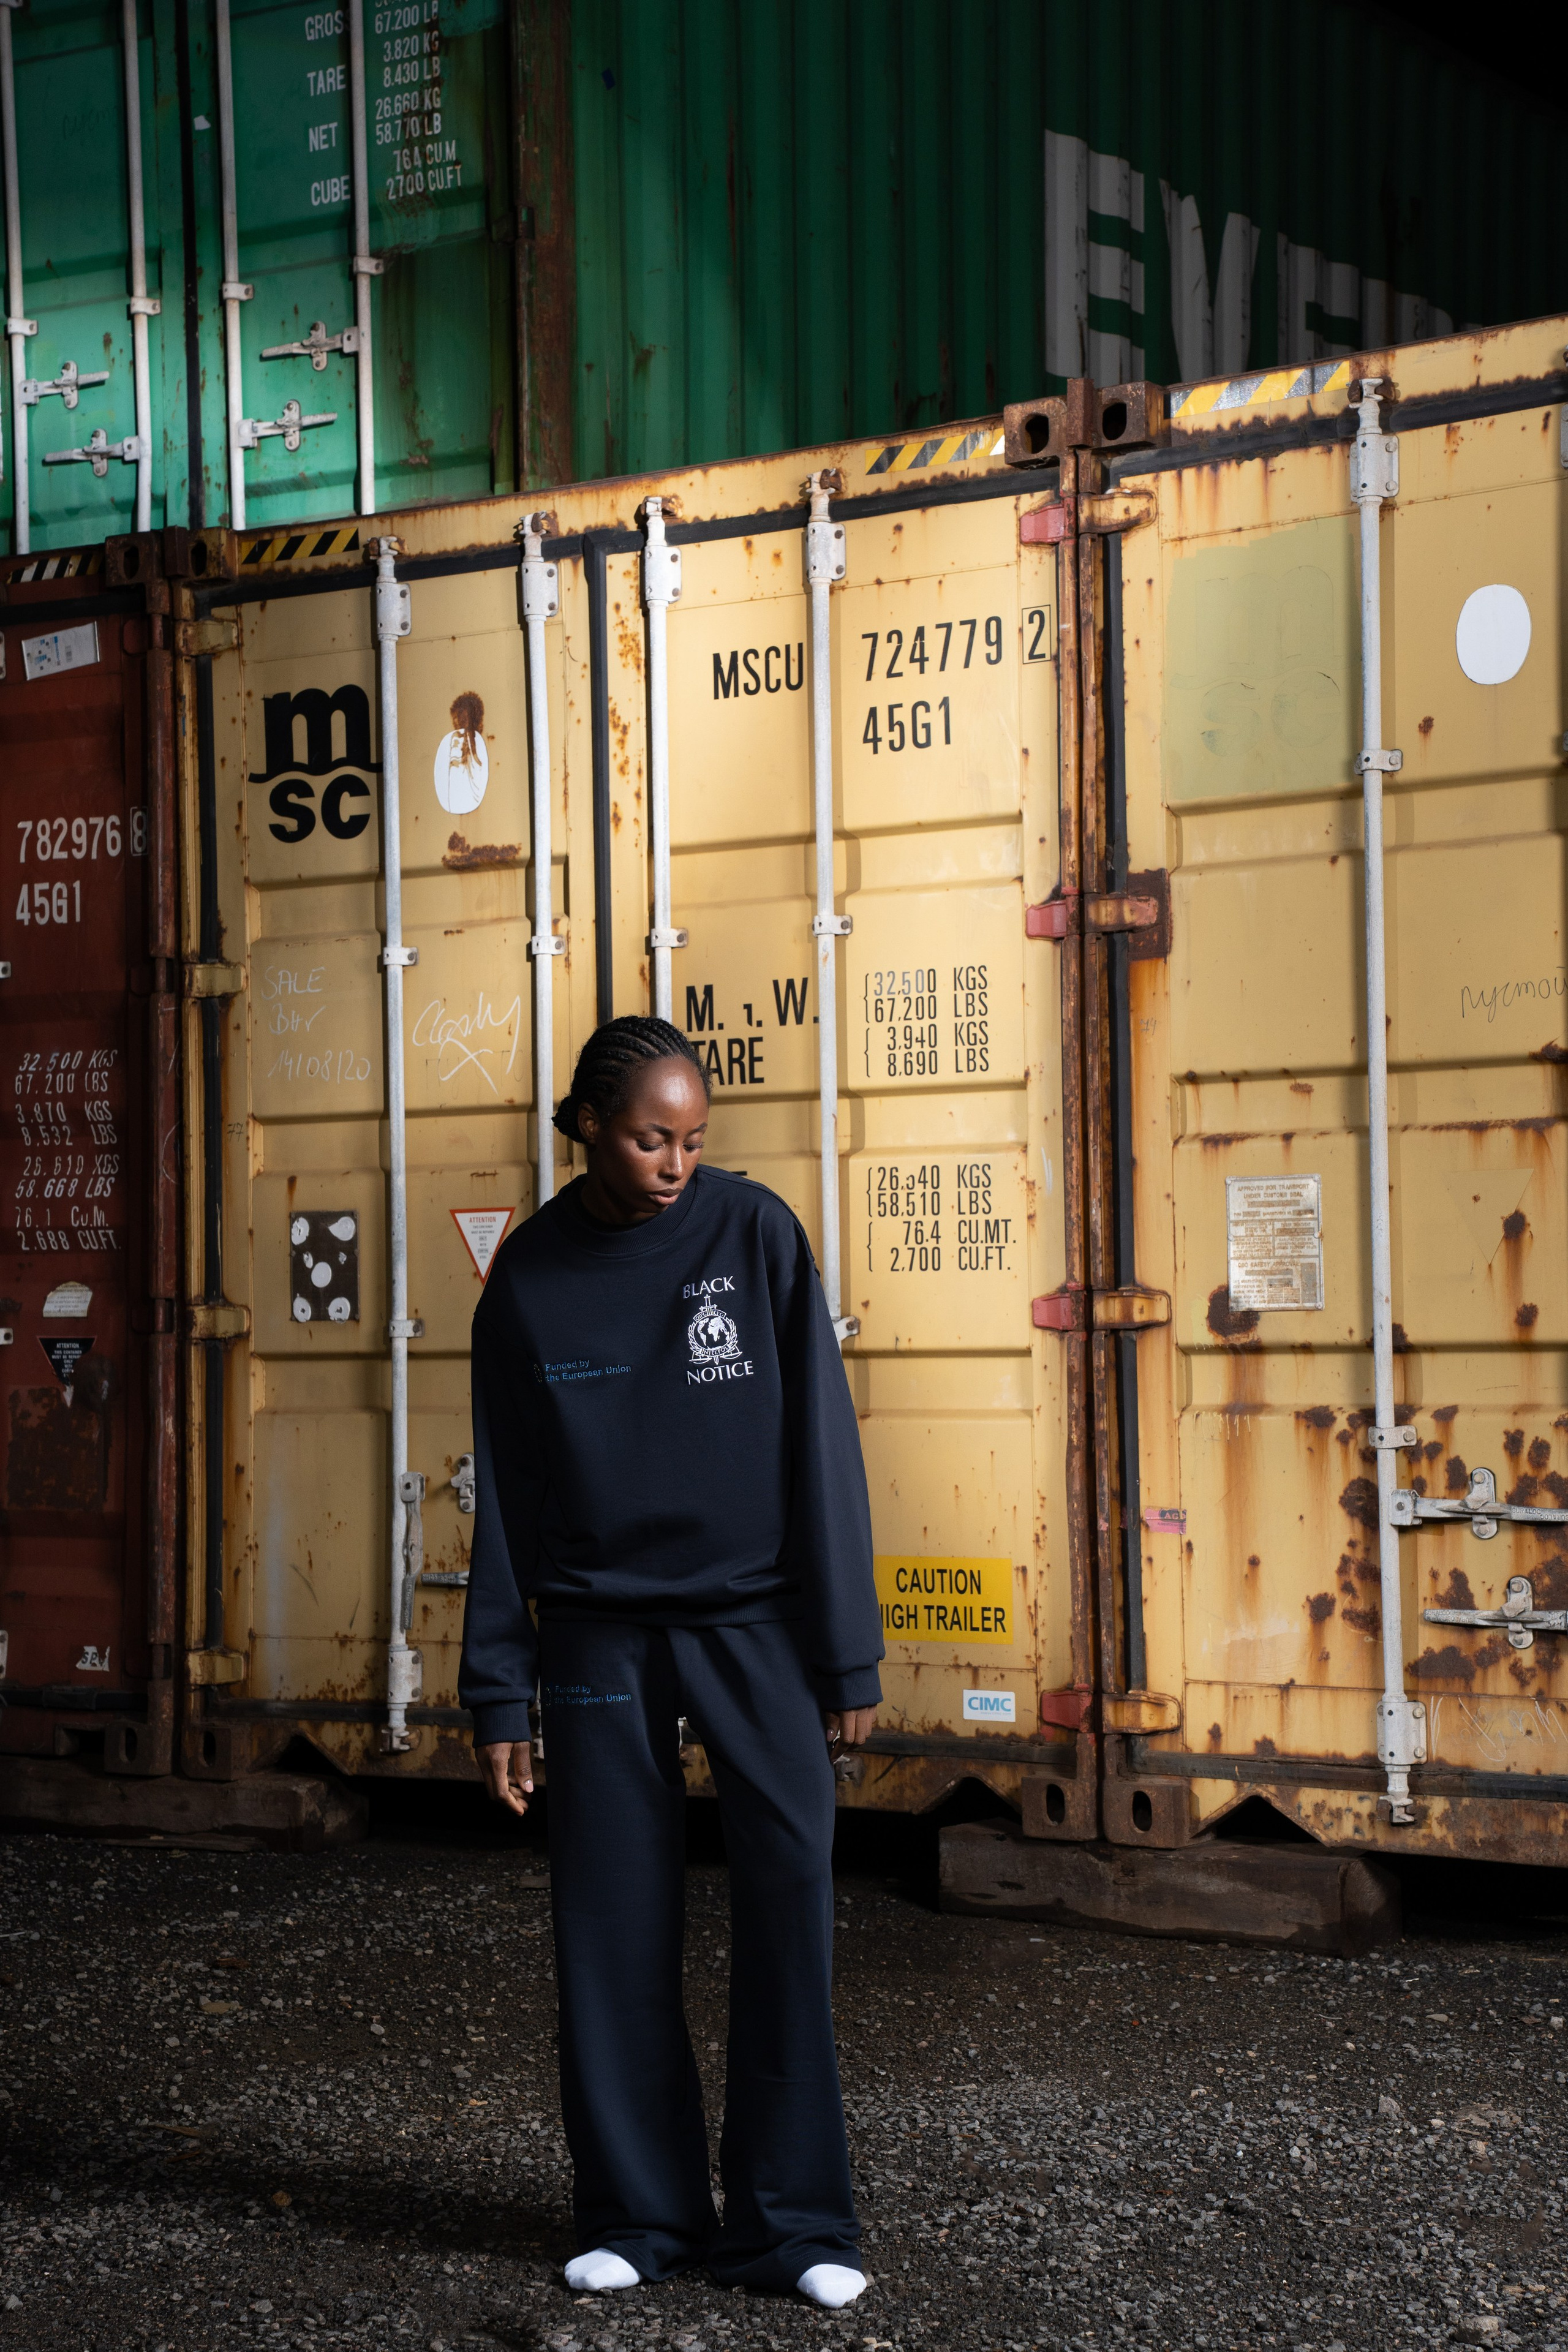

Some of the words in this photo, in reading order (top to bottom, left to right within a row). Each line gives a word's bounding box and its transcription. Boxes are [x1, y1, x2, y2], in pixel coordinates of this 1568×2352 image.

[305, 10, 350, 41] GROS
[375, 5, 419, 34] 67.200
[424, 0, 439, 23] LB
[383, 35, 419, 62] 3.820
[423, 31, 439, 53] KG
[307, 64, 346, 96] TARE
[383, 61, 419, 88] 8.430
[423, 56, 440, 80] LB
[375, 91, 420, 120] 26.660
[423, 86, 441, 110] KG
[309, 122, 338, 153] NET
[375, 116, 421, 145] 58.770
[424, 113, 442, 135] LB
[311, 175, 351, 206] CUBE
[427, 165, 462, 191] CU.FT
[861, 616, 1003, 682] 724779
[1028, 609, 1046, 660] 2
[712, 642, 804, 699] MSCU
[862, 696, 952, 755] 45G1
[17, 815, 122, 864] 782976
[132, 810, 147, 852] 8
[16, 880, 81, 925] 45G1
[262, 965, 326, 1000] SALE
[873, 968, 937, 997] 32,500
[954, 965, 987, 991] KGS
[686, 984, 724, 1033] M.
[772, 977, 820, 1027] W.
[875, 995, 937, 1023] 67,200
[954, 992, 988, 1018] LBS
[888, 1023, 937, 1051] 3,940
[954, 1020, 989, 1047] KGS
[19, 1050, 83, 1071] 32.500
[88, 1049, 118, 1069] KGS
[888, 1050, 938, 1077] 8,690
[955, 1047, 989, 1073] LBS
[15, 1073, 75, 1095] 67.200
[85, 1072, 108, 1093] LBS
[15, 1102, 67, 1123] 3.870
[85, 1101, 113, 1121] KGS
[21, 1126, 73, 1147] 8.532
[91, 1124, 118, 1145] LBS
[23, 1155, 84, 1176] 26.610
[92, 1154, 119, 1175] KGS
[957, 1164, 992, 1189] KGS
[15, 1178, 78, 1199] 58.668
[85, 1177, 115, 1198] LBS
[15, 1206, 51, 1228] 76.1
[878, 1191, 940, 1217] 58,510
[958, 1190, 992, 1215] LBS
[17, 1231, 70, 1251] 2.688
[903, 1220, 941, 1245] 76.4
[958, 1219, 1016, 1244] CU.MT.
[891, 1246, 941, 1272] 2,700
[959, 1246, 1011, 1271] CU.FT.
[683, 1276, 735, 1298] BLACK
[701, 1345, 729, 1356] INTERPOL
[545, 1360, 578, 1371] Funded
[579, 1360, 590, 1368] by
[562, 1369, 603, 1380] European
[606, 1365, 631, 1374] Union
[687, 1360, 754, 1385] NOTICE
[895, 1567, 982, 1594] CAUTION
[880, 1604, 918, 1629] IGH
[924, 1605, 1006, 1633] TRAILER
[566, 1696, 604, 1705] European
[606, 1693, 631, 1702] Union
[582, 1685, 592, 1694] by
[968, 1696, 1011, 1712] CIMC
